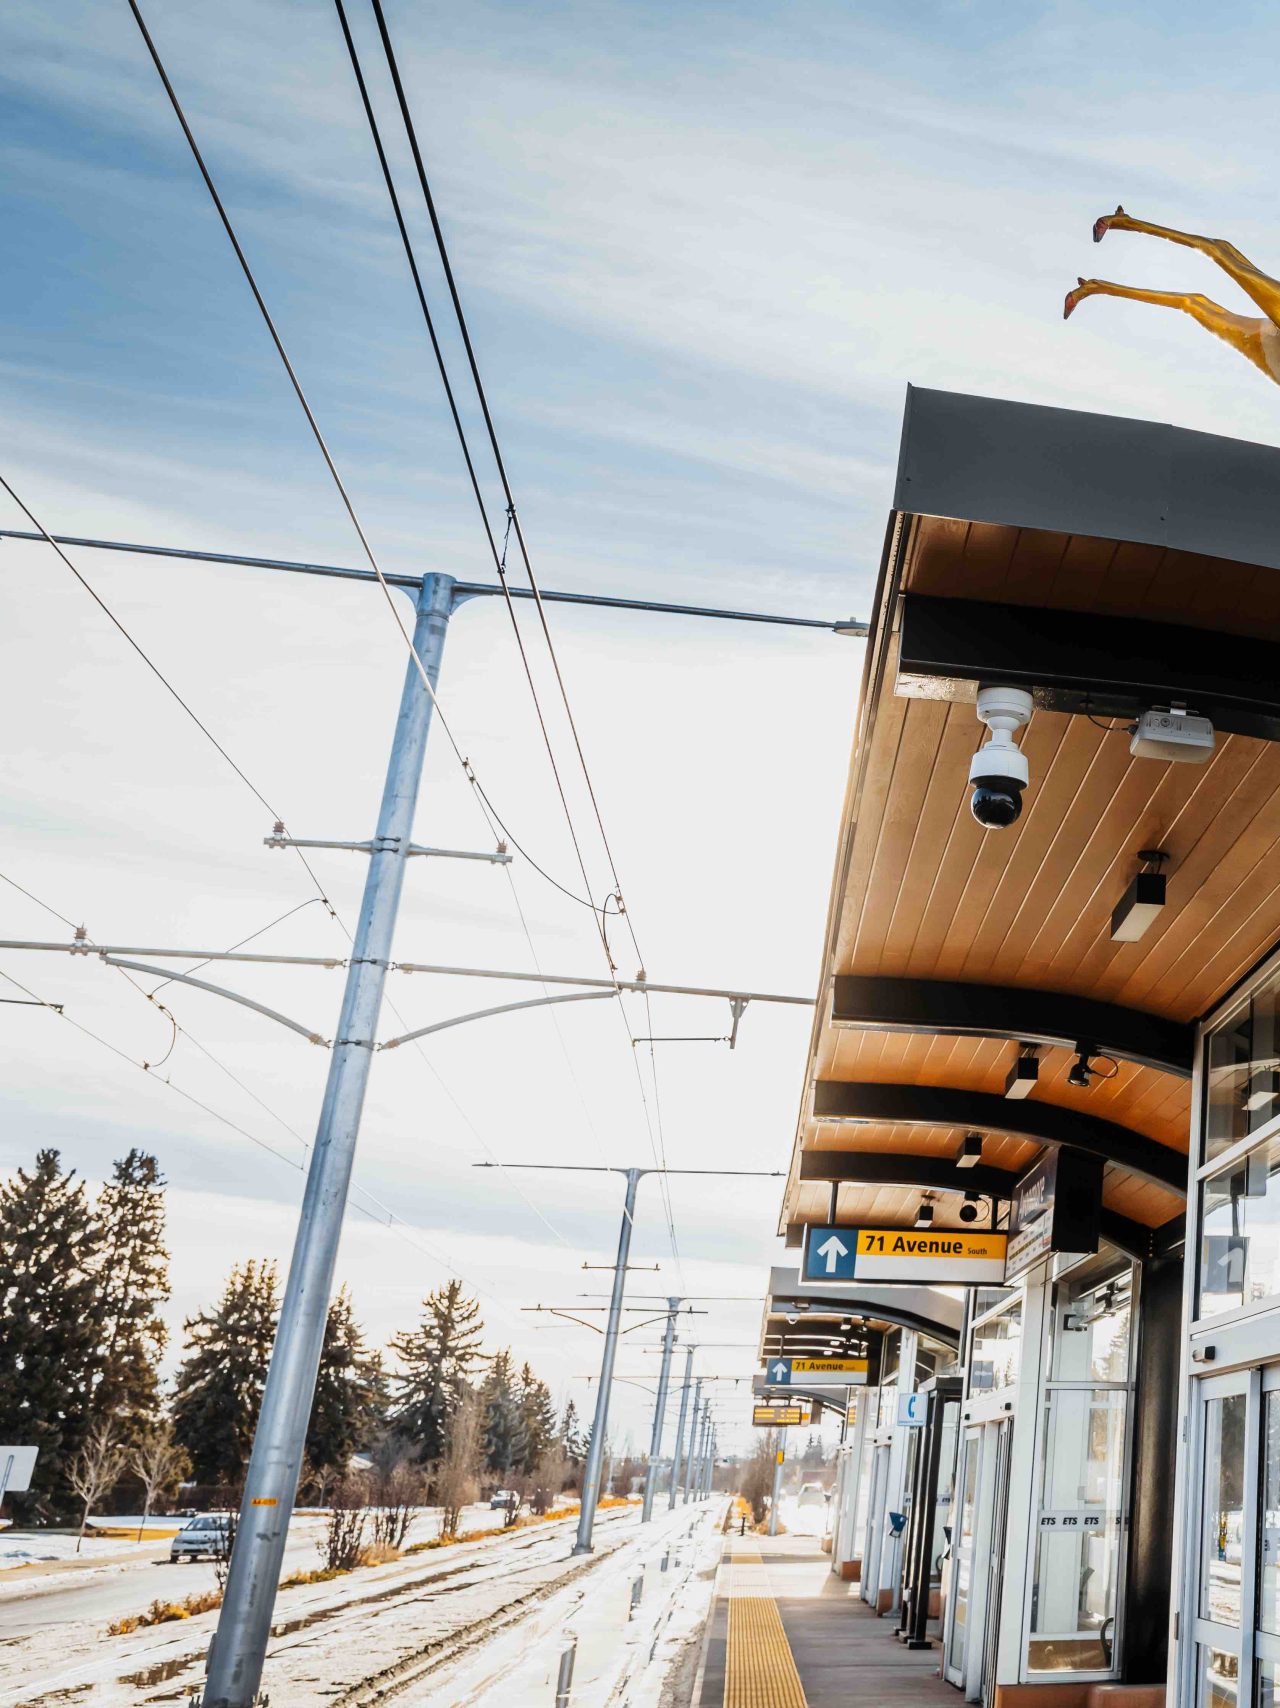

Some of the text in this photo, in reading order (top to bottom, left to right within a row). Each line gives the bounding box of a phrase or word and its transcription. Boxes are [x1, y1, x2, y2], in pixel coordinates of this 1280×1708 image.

[865, 1235, 988, 1255] 71 Avenue South
[795, 1362, 806, 1371] 71
[809, 1362, 844, 1371] Avenue
[1040, 1516, 1100, 1526] ETS ETS ETS
